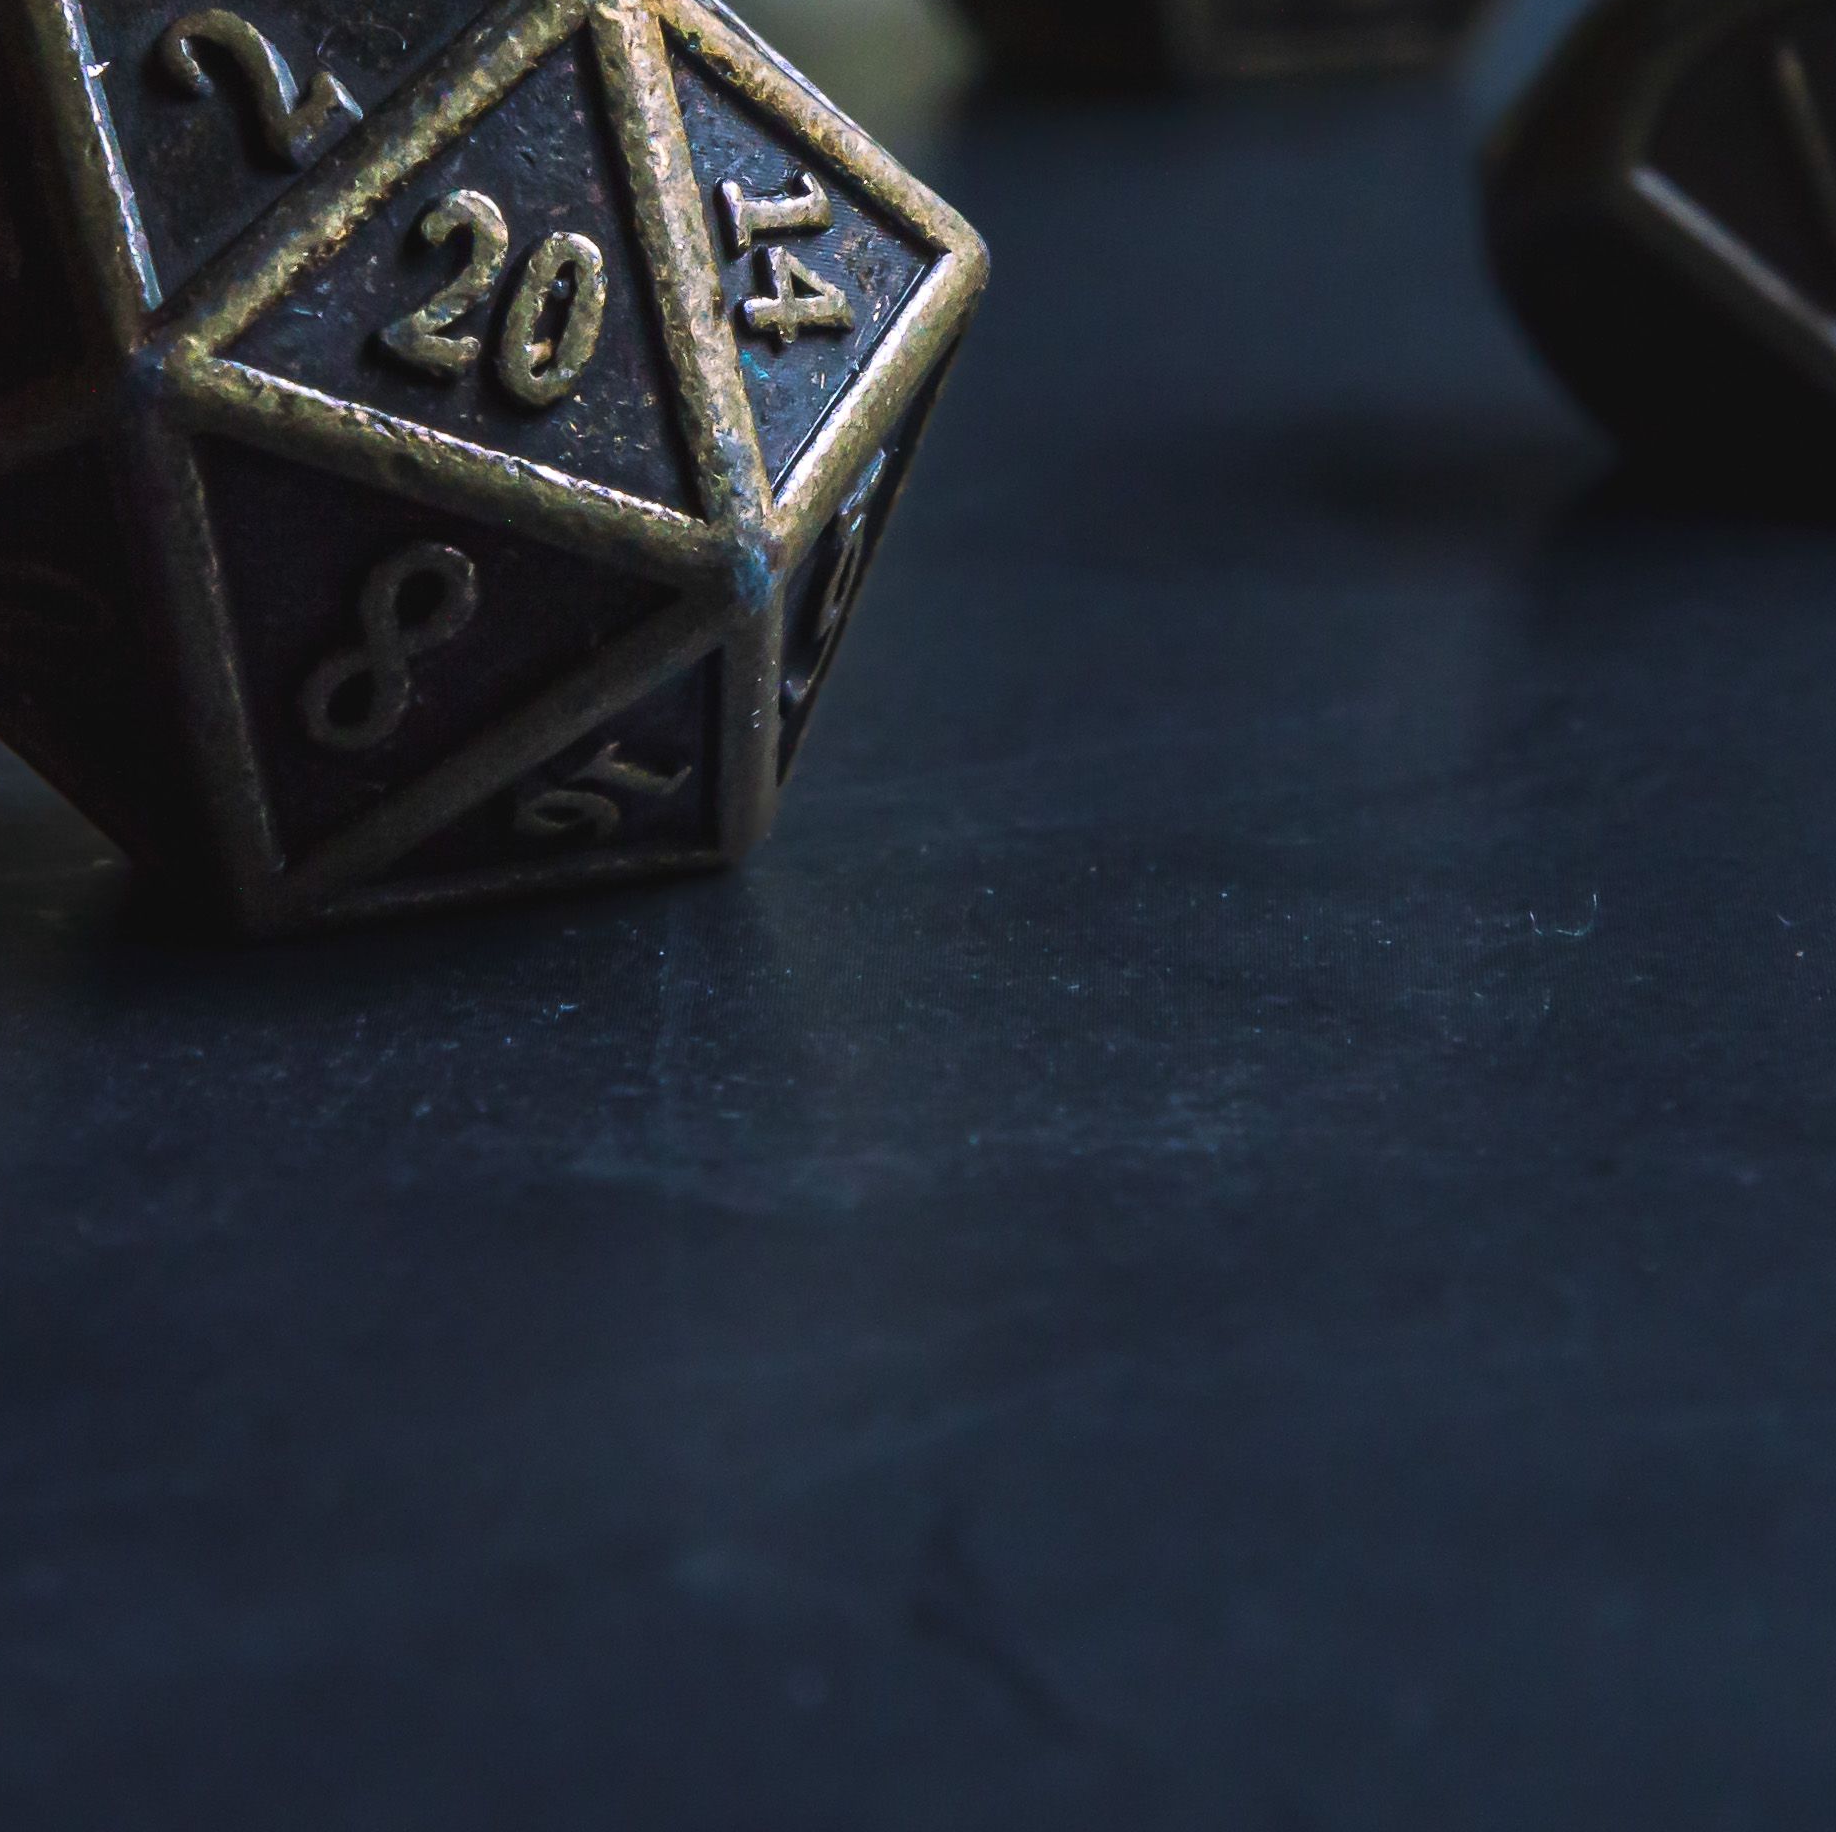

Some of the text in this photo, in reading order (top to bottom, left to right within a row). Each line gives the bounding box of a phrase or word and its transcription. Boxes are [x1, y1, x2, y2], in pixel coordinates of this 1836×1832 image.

[157, 6, 365, 170] 2
[378, 188, 608, 408] 20
[715, 170, 857, 348] 14
[298, 540, 478, 752] 8
